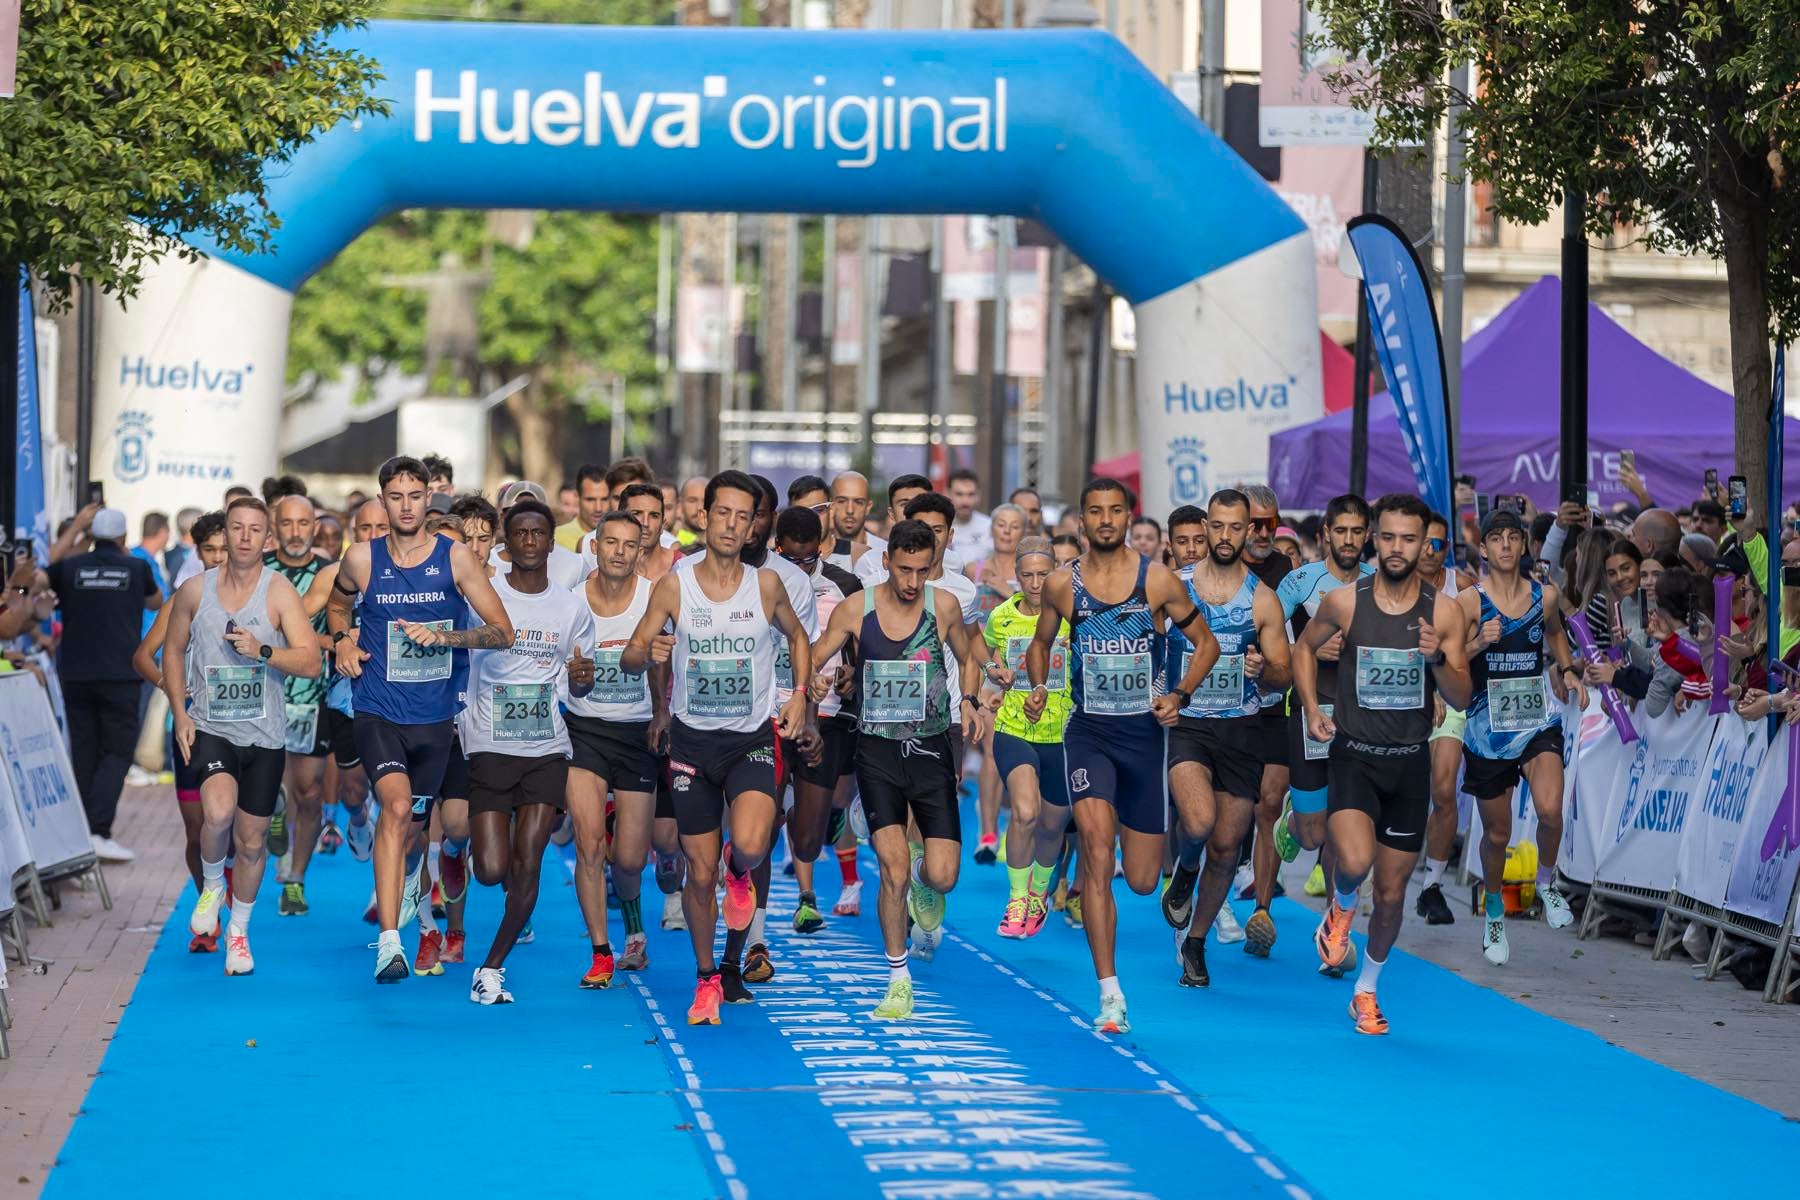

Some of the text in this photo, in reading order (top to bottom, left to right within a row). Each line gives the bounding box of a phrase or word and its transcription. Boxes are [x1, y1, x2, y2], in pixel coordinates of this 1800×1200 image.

[414, 68, 1006, 168] Huelva original
[119, 355, 244, 394] Huelva
[1164, 377, 1289, 414] Huelva
[158, 462, 234, 480] HUELVA
[1510, 450, 1645, 484] AVTE
[376, 591, 445, 604] TROTASIERRA
[692, 619, 712, 627] TEAM
[729, 610, 753, 619] JULIÁN
[513, 629, 542, 640] CUITO
[688, 633, 755, 654] bathco
[1079, 634, 1149, 653] Huelva
[1018, 654, 1063, 670] 28
[1486, 652, 1538, 661] CLUB ONUBENSE
[392, 668, 418, 677] Huelva
[1489, 661, 1535, 671] DE ATLETISMO
[1096, 672, 1147, 691] 2106
[1201, 672, 1238, 688] 151
[1369, 668, 1420, 685] 2259
[217, 682, 262, 700] 2090
[698, 677, 750, 695] 2132
[871, 680, 921, 698] 2172
[504, 701, 549, 720] 2343
[690, 705, 716, 713] Huelva
[1089, 700, 1148, 709] Huelva AVATEL
[1501, 694, 1543, 711] 2139
[211, 708, 234, 717] Huelva
[1346, 739, 1421, 755] NIKE PRO
[1634, 789, 1689, 833] HUELVA
